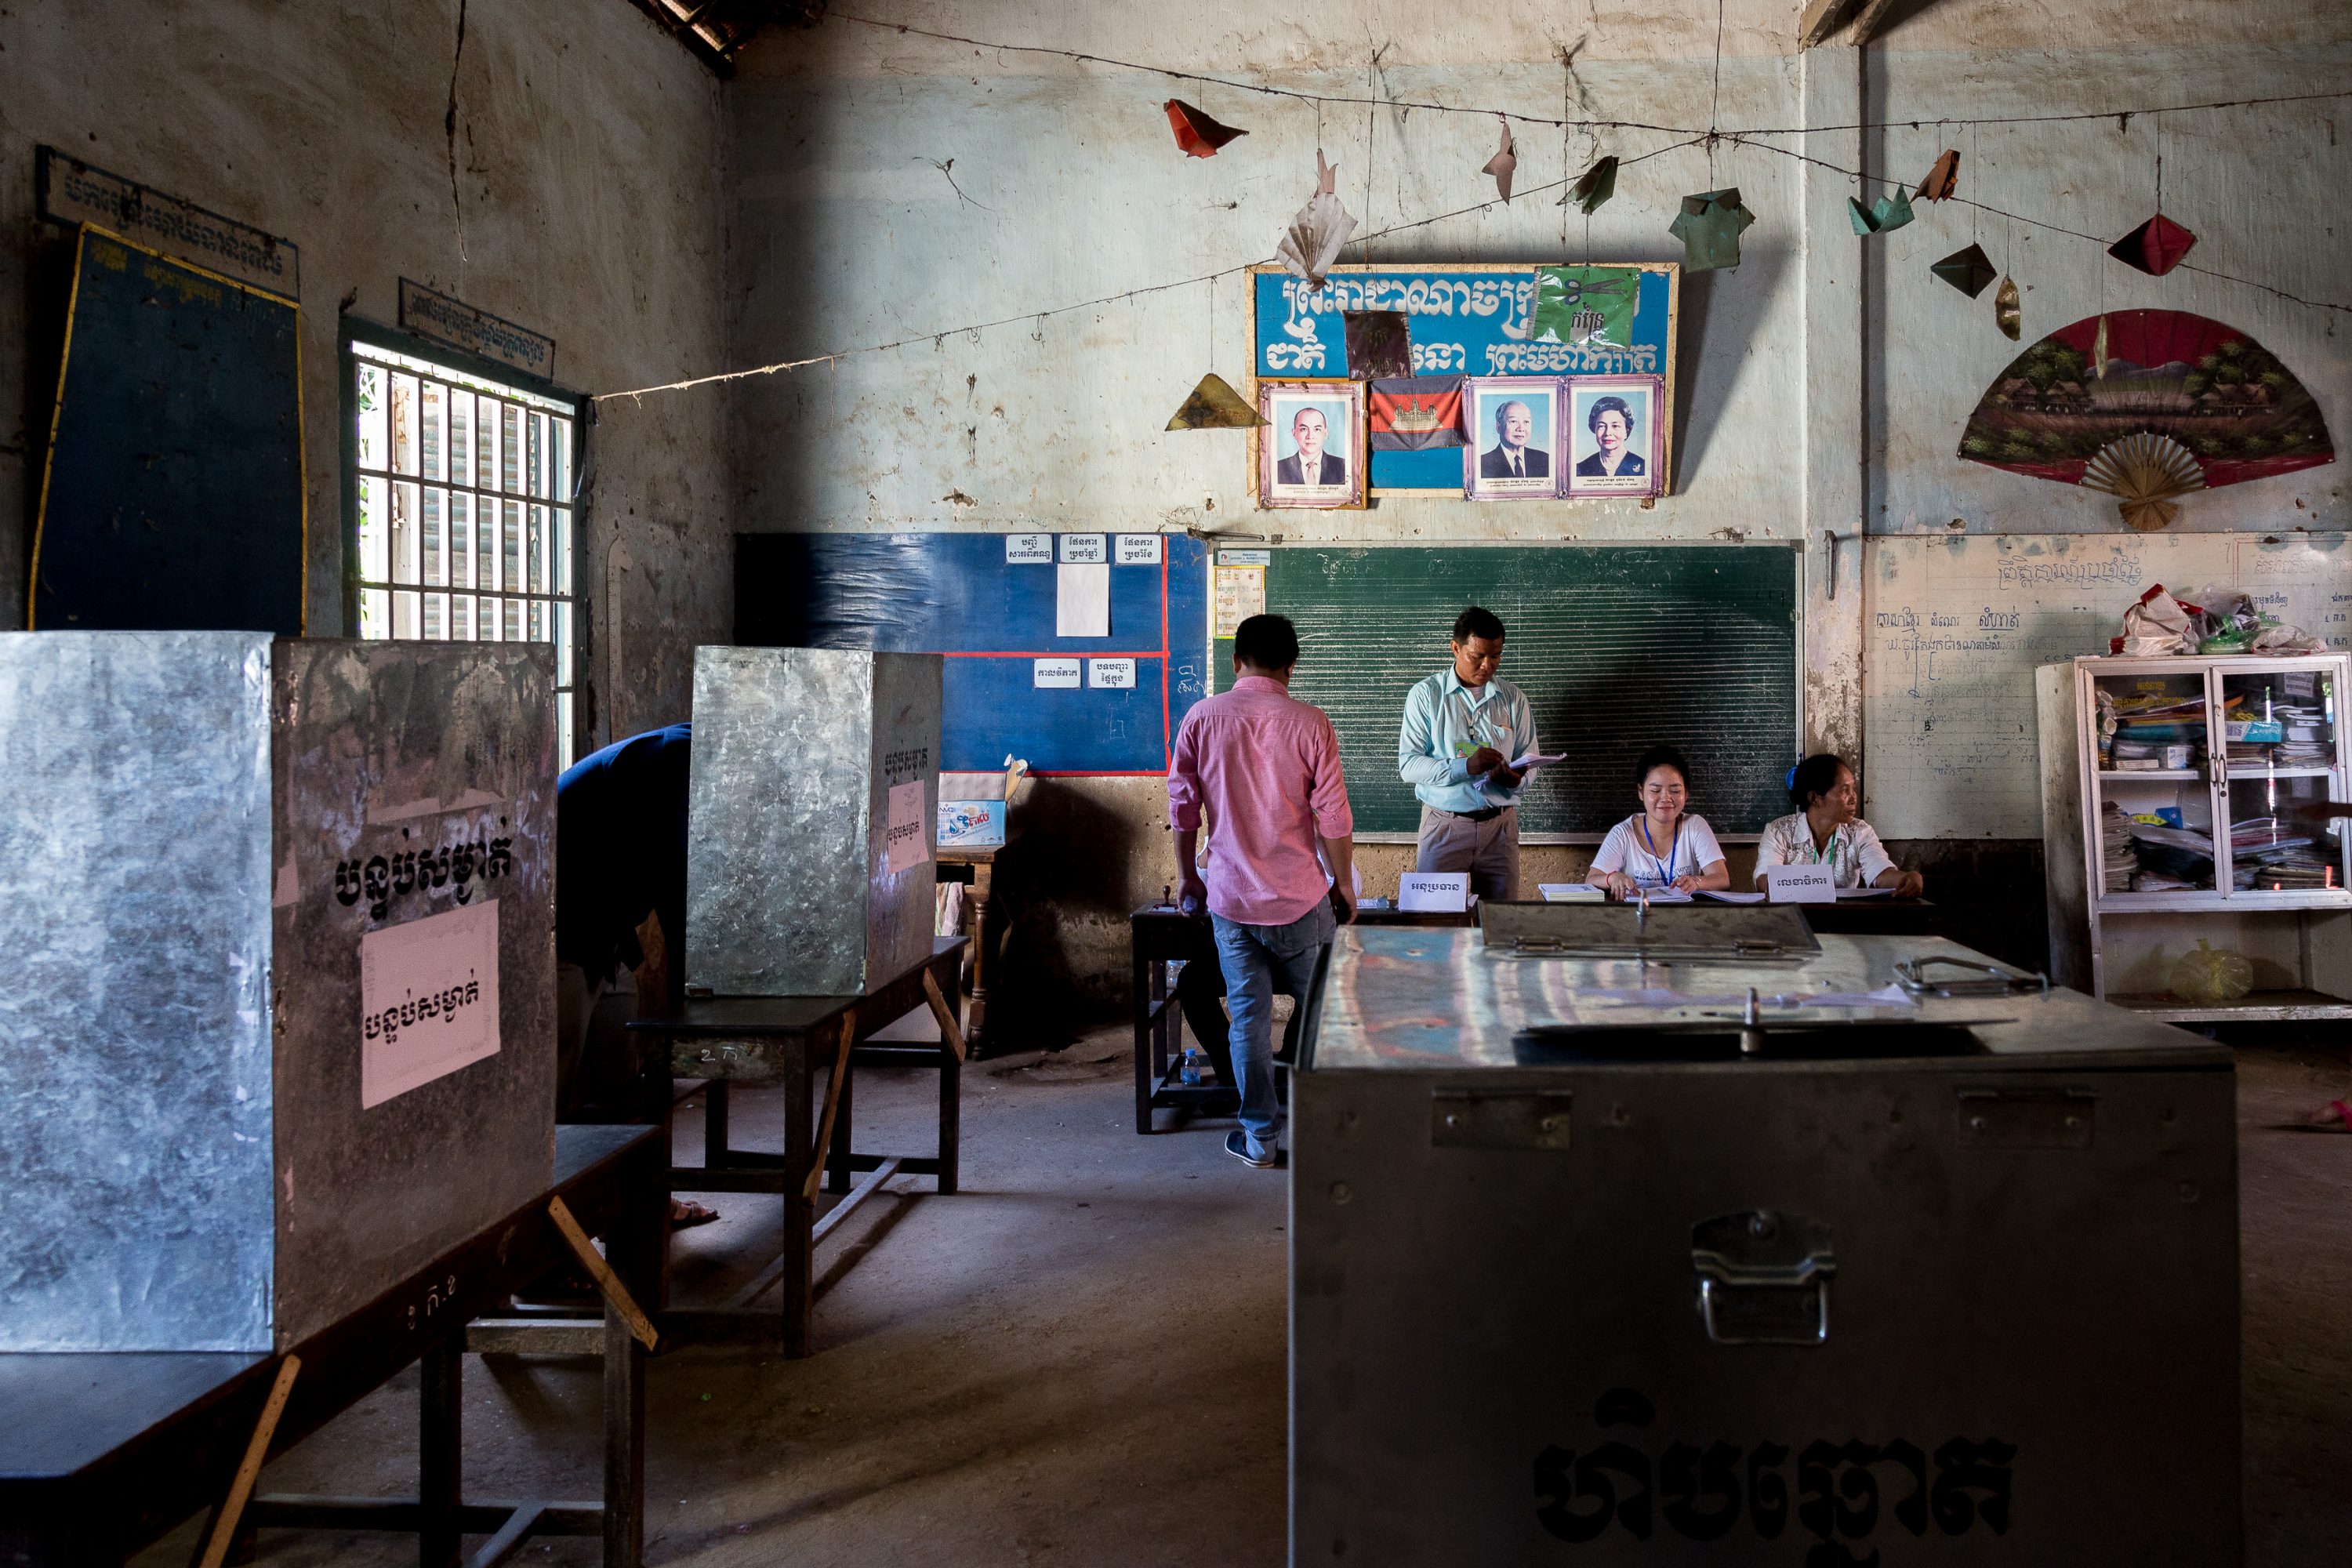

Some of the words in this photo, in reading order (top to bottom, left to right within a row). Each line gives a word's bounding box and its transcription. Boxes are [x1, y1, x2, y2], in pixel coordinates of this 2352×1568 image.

[1069, 537, 1098, 546] ផែនការ
[1124, 537, 1153, 546] ផែនការ
[884, 735, 928, 784] បន្ទប់សម្ងាត់
[888, 814, 920, 844] បន្ទប់សម្ងាត់
[335, 816, 513, 920] បន្ទប់សម្ងាត់
[1411, 882, 1460, 893] អនុប្រធាន
[1777, 874, 1828, 887] លេខាធិការ
[365, 968, 480, 1044] បន្ទប់សម្ងាត់
